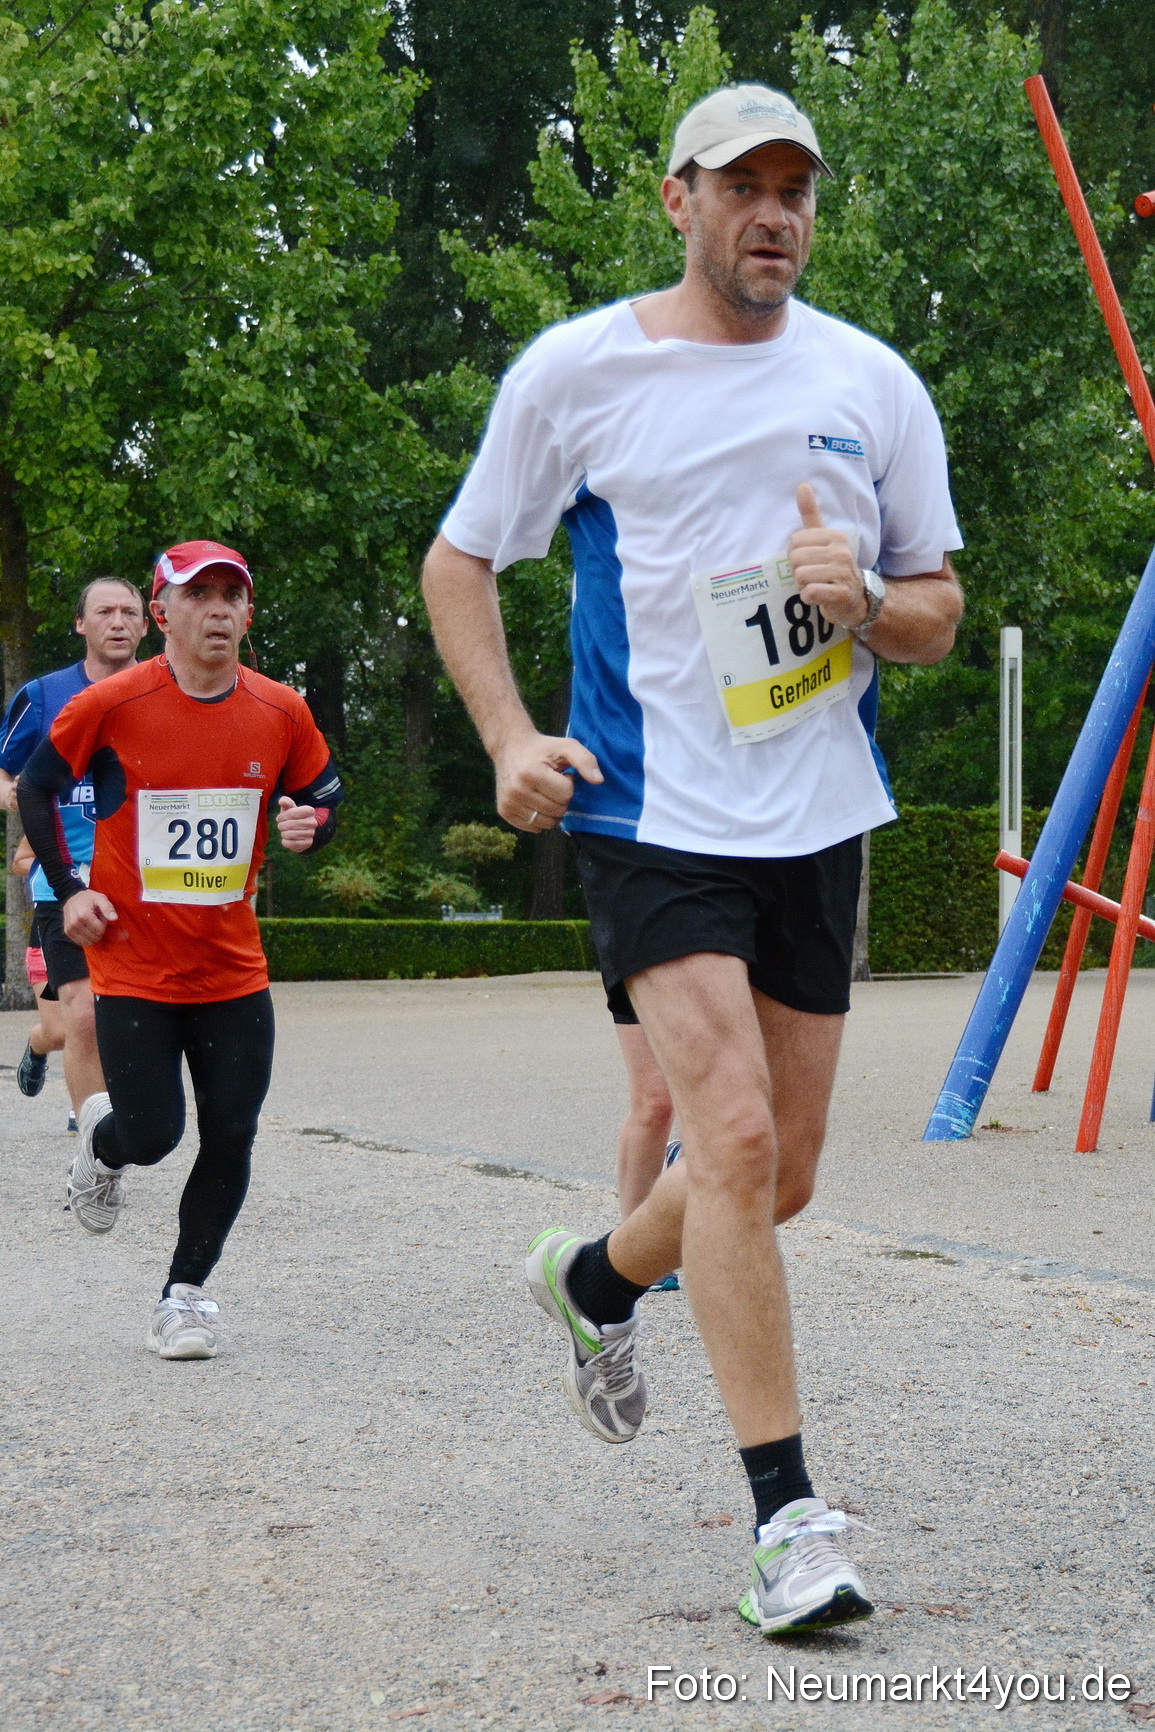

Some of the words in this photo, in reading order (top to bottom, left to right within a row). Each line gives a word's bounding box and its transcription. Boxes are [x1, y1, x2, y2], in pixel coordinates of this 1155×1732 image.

[711, 579, 770, 601] NeuerMarkt
[723, 675, 732, 686] D
[769, 658, 831, 709] Gerhard
[149, 803, 190, 811] NeuerMarkt
[198, 793, 250, 808] BOCK
[168, 817, 239, 860] 280
[183, 871, 228, 889] Oliver
